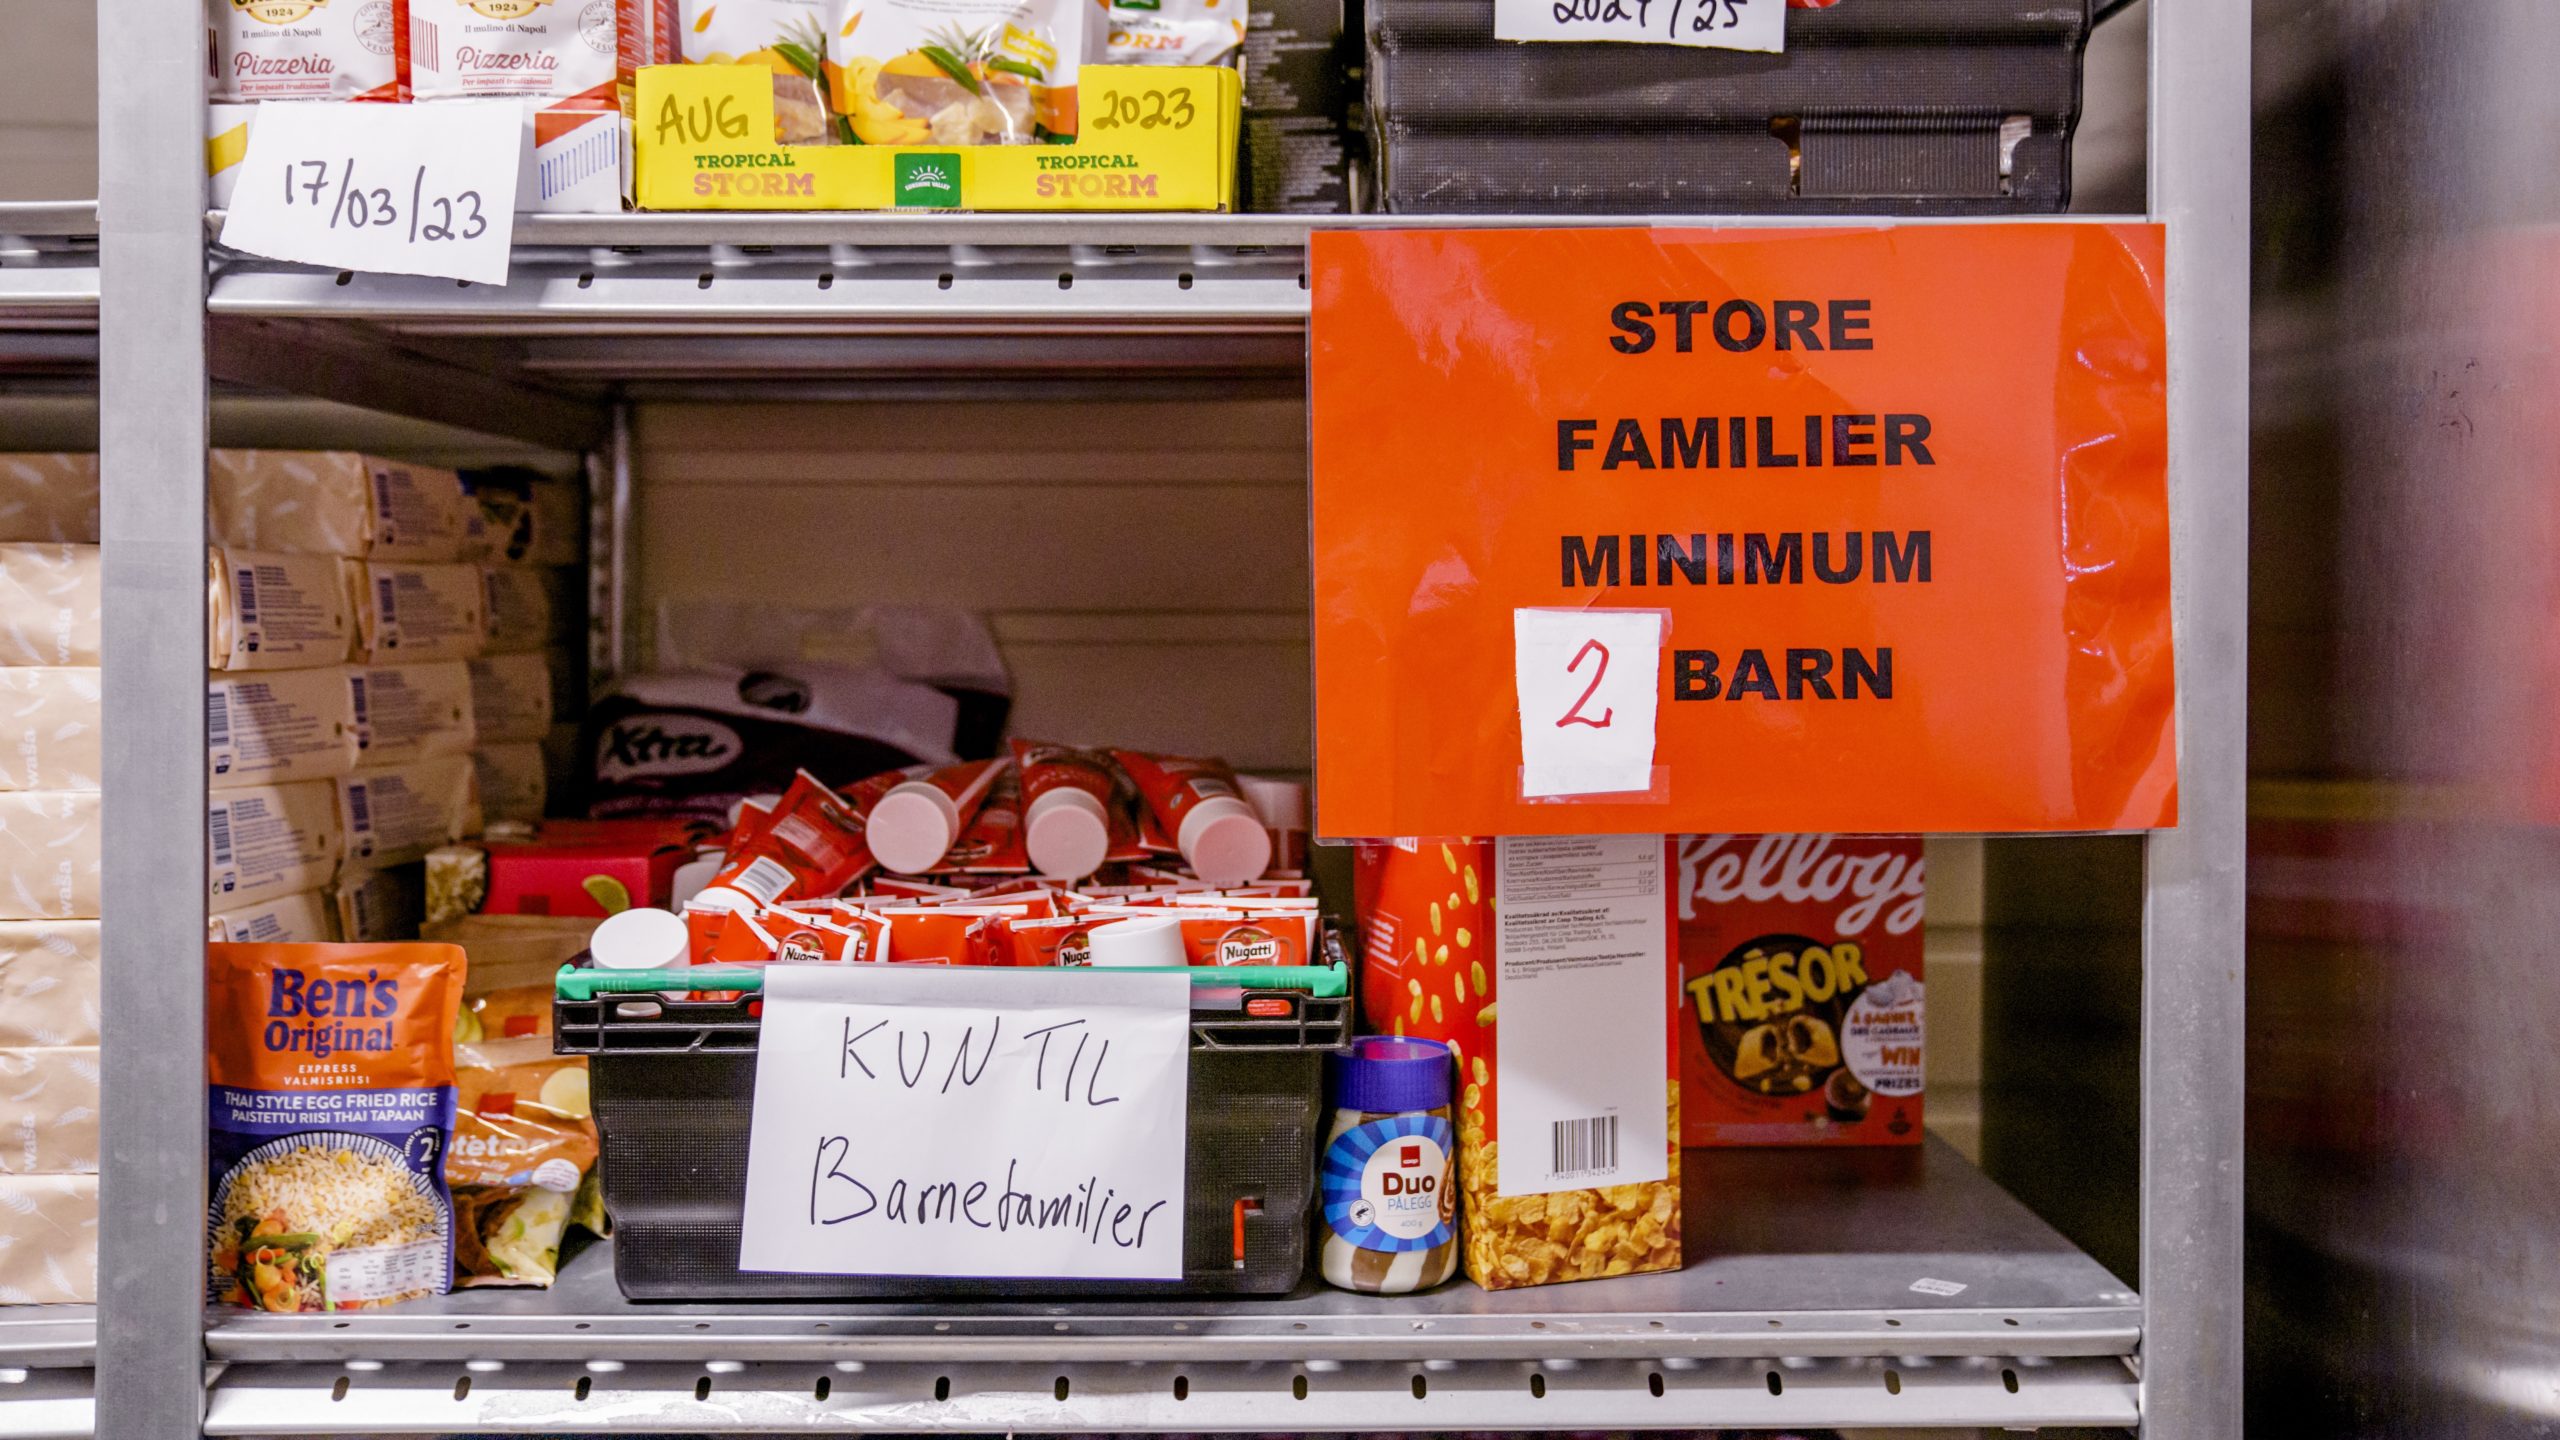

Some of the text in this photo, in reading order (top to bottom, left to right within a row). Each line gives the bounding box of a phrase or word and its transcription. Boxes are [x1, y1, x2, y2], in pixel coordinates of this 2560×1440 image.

[266, 8, 294, 17] 1924
[489, 3, 519, 12] 1924
[250, 29, 280, 38] mulino
[282, 28, 291, 38] di
[292, 28, 322, 38] Napoli
[473, 24, 504, 33] mulino
[505, 24, 515, 33] di
[517, 24, 547, 34] Napoli
[234, 51, 335, 76] Pizzeria
[456, 46, 559, 71] Pizzeria
[240, 83, 253, 92] Per
[462, 78, 475, 87] Per
[656, 87, 1195, 146] AUG 2023
[694, 153, 795, 169] TROPICAL
[1036, 155, 1139, 170] TROPICAL
[693, 173, 816, 197] STORM
[1036, 174, 1159, 198] STORM
[284, 158, 487, 243] 17/03/23
[1609, 299, 1873, 354] STORE
[1557, 413, 1936, 470] FAMILIER
[1561, 530, 1931, 587] MINIMUM
[1556, 638, 1893, 728] 2 BARN
[604, 725, 728, 767] Xtra
[1225, 943, 1272, 961] Nugatti
[266, 968, 399, 1018] Ben's
[1687, 943, 1868, 1023] TRÉSOR
[264, 1020, 394, 1059] Original
[841, 1016, 1120, 1106] KUN TIL
[1881, 1046, 1920, 1066] WIN
[298, 1063, 357, 1074] EXPRESS
[284, 1076, 370, 1086] VALMISRIISI
[224, 1091, 438, 1110] THAI STYLE EGG FRIED RICE
[232, 1109, 424, 1124] PAISTETTU RIISI THAI TAPAAN
[419, 1137, 433, 1162] 2
[1382, 1172, 1436, 1196] Duo
